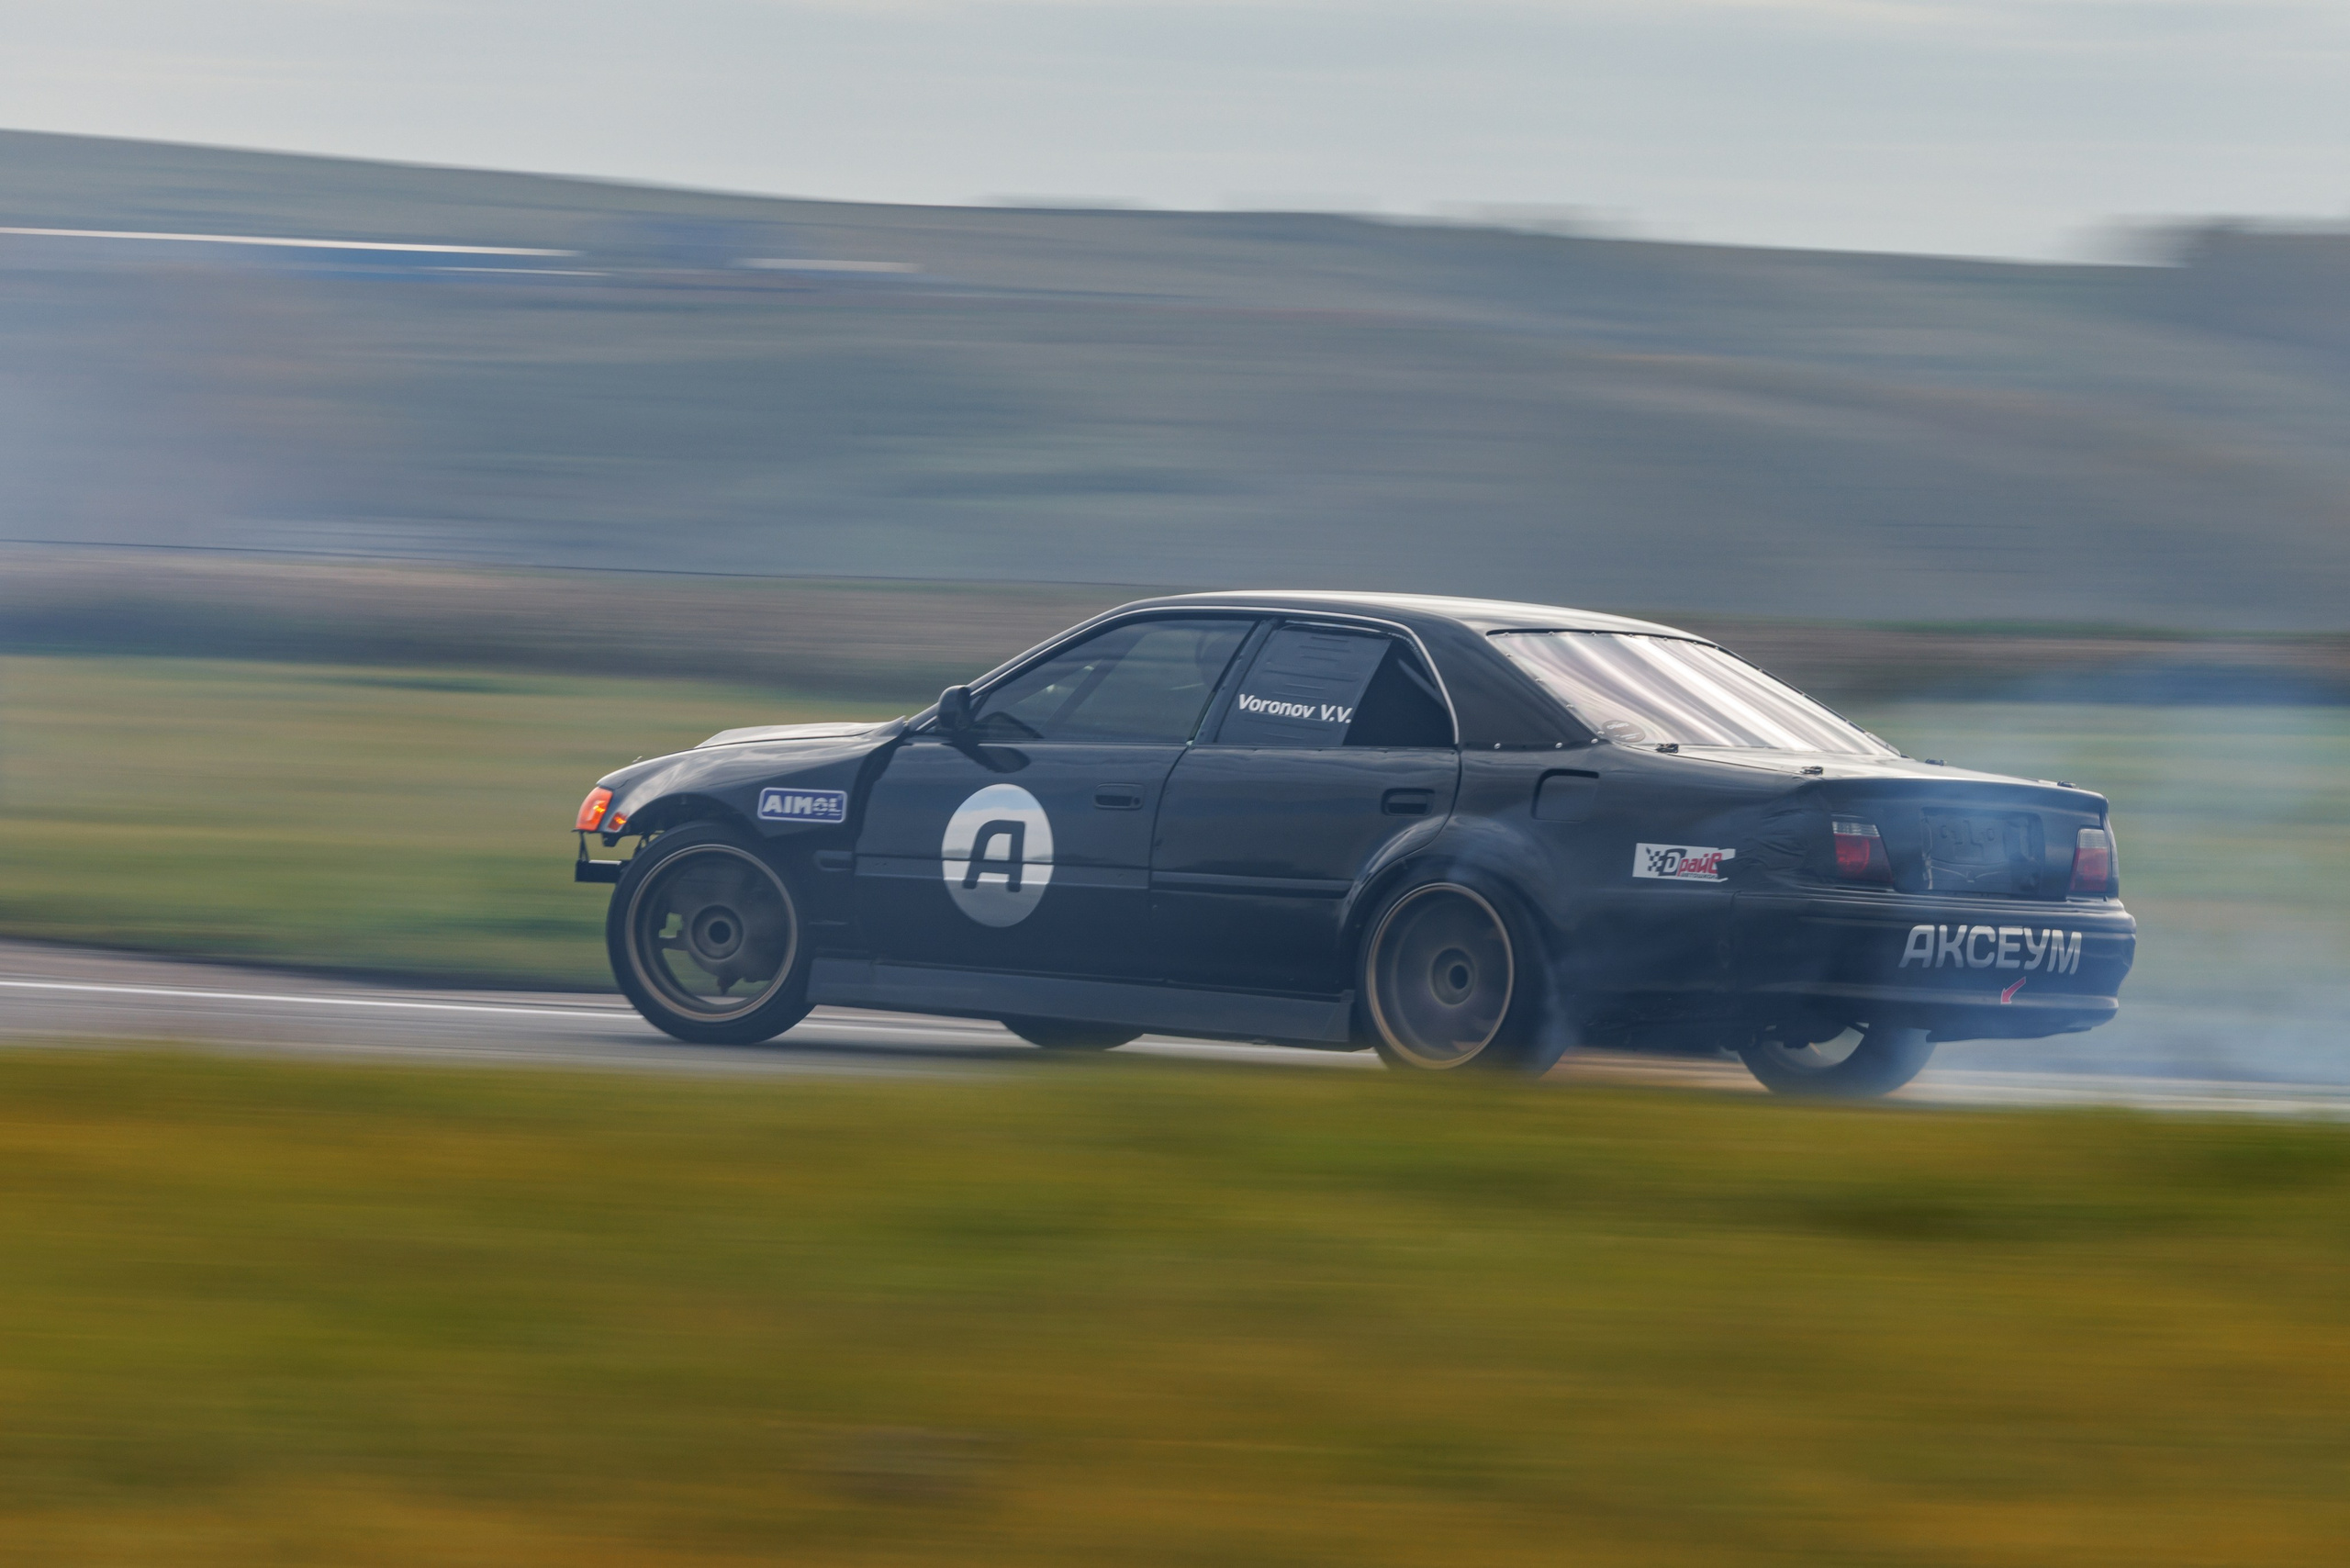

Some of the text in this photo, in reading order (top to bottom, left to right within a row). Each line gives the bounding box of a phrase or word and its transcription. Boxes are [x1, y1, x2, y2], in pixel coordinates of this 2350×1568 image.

[1239, 694, 1352, 723] Voronov V.V.
[762, 795, 842, 816] AIMOL
[1899, 924, 2082, 975] АКСЕУМ
